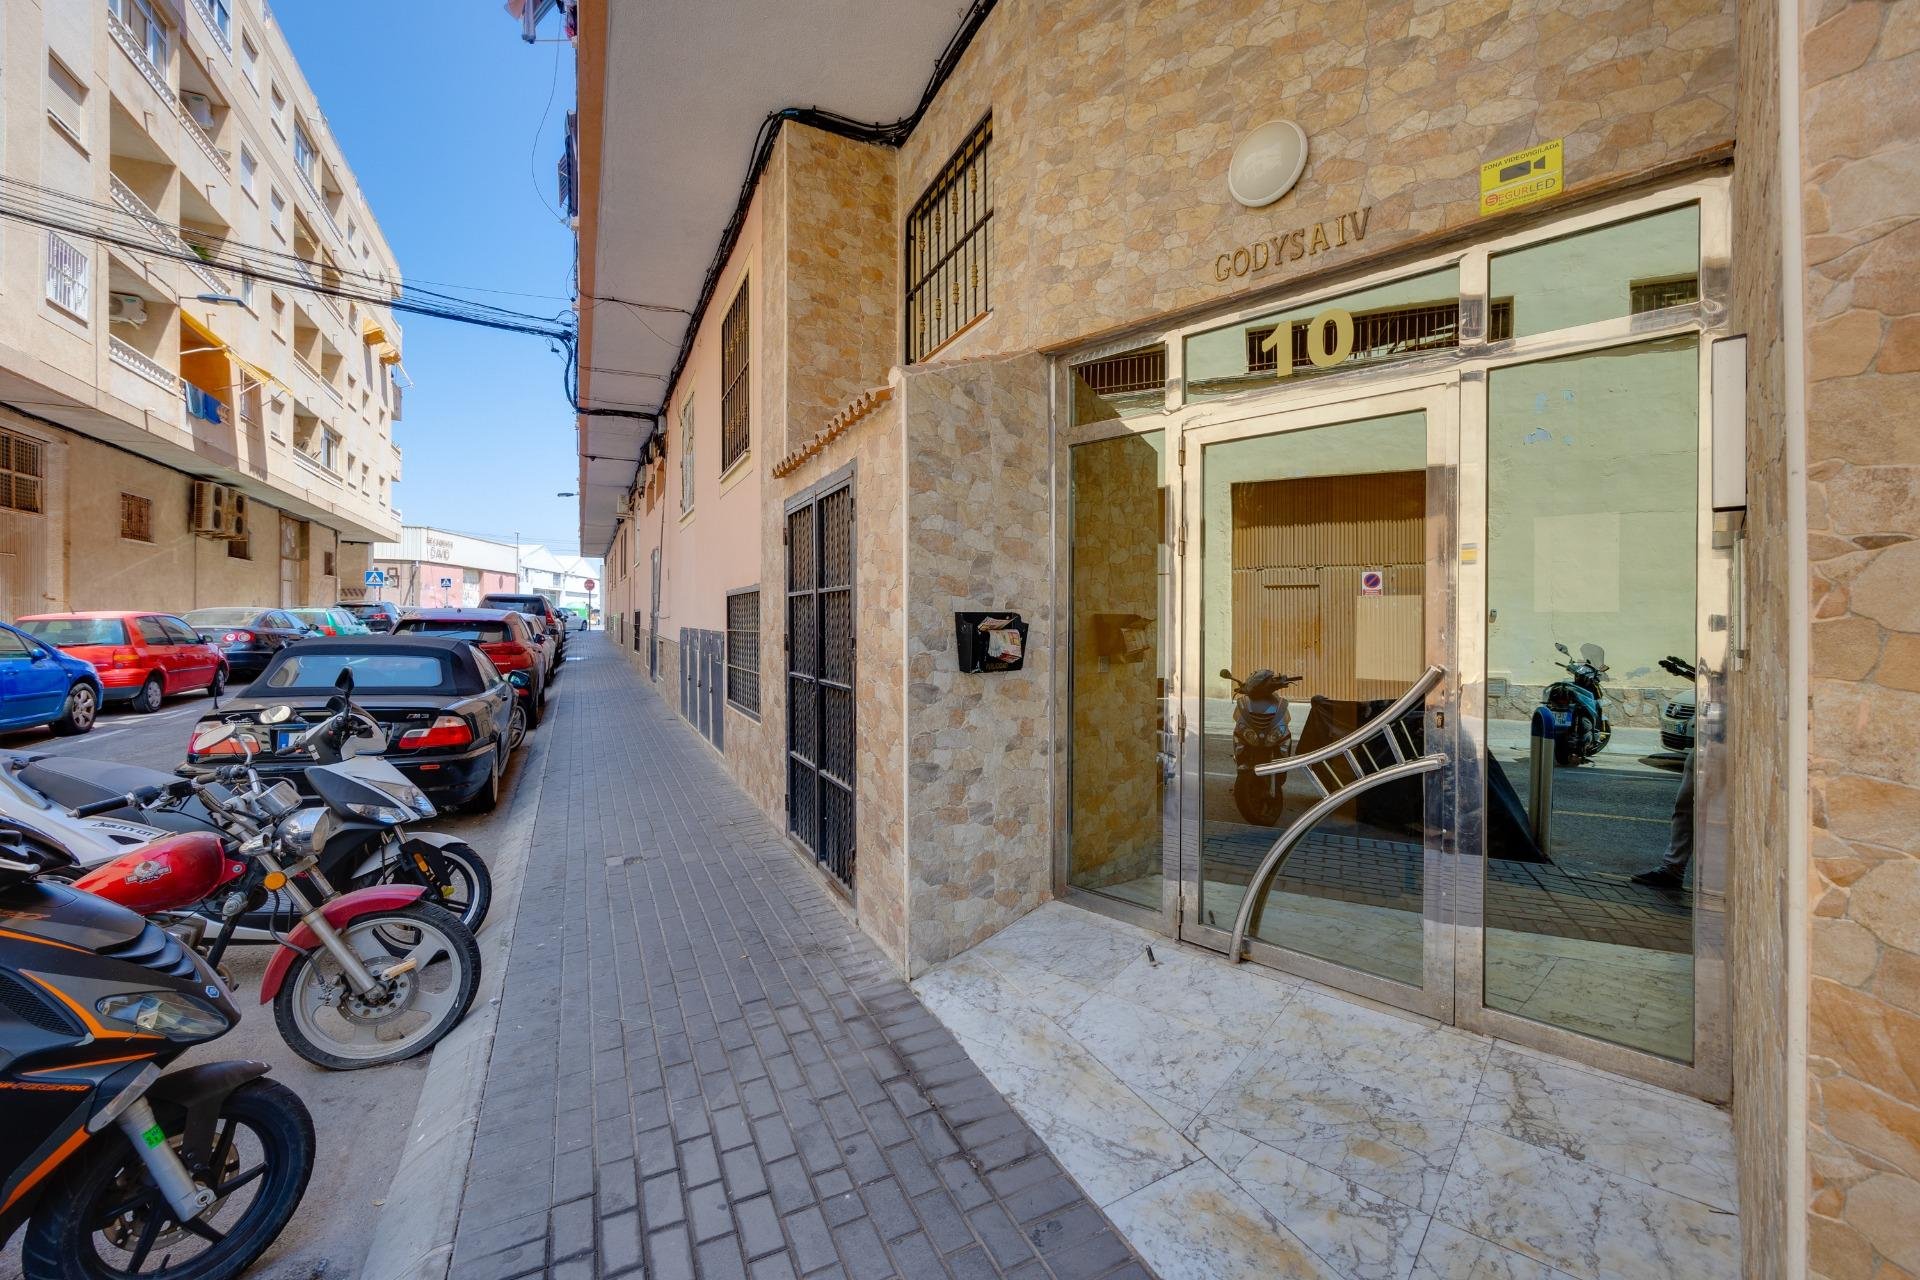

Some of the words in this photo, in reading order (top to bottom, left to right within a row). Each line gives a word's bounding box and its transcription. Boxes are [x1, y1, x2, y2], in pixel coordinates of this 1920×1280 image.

[1483, 161, 1502, 172] ZONA
[1504, 142, 1560, 164] VIDEOVIGILADA
[1485, 178, 1556, 206] SEGURLED
[1261, 307, 1355, 378] 10
